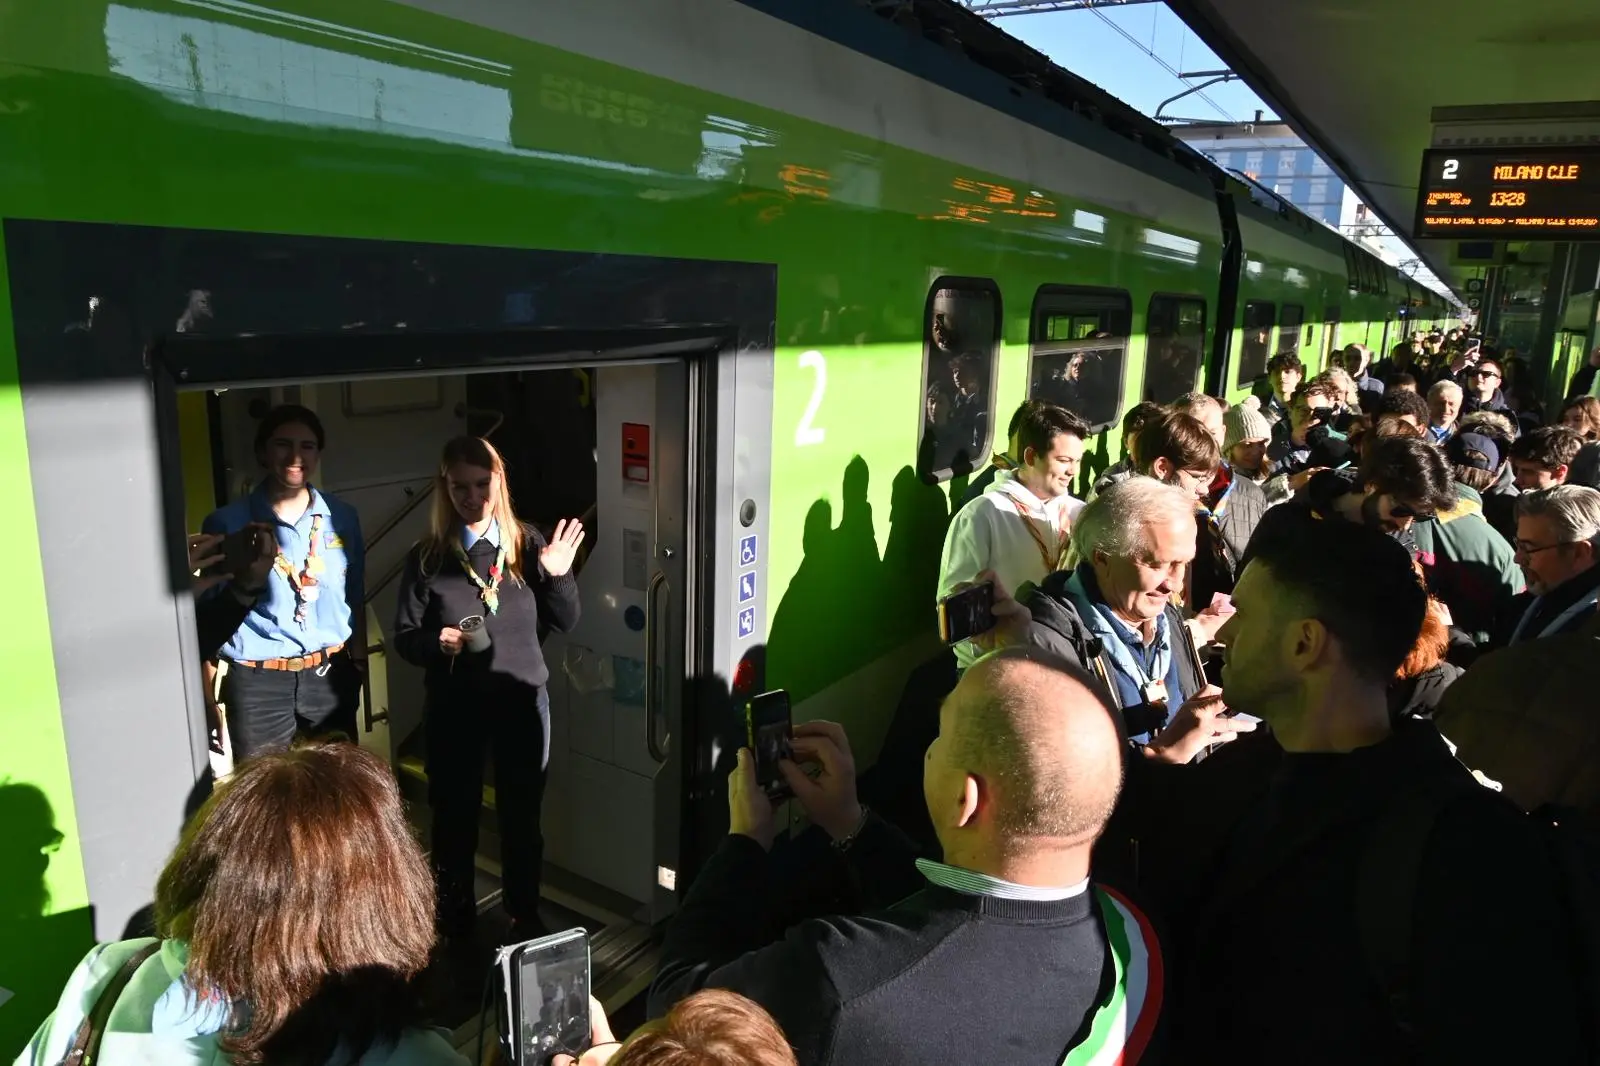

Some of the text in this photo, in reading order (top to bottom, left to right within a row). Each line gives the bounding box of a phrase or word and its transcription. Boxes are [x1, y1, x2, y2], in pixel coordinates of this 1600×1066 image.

[1442, 159, 1459, 180] 2
[1493, 165, 1579, 180] MILANO C.LE
[1489, 192, 1526, 206] 13:28
[795, 350, 827, 447] 2
